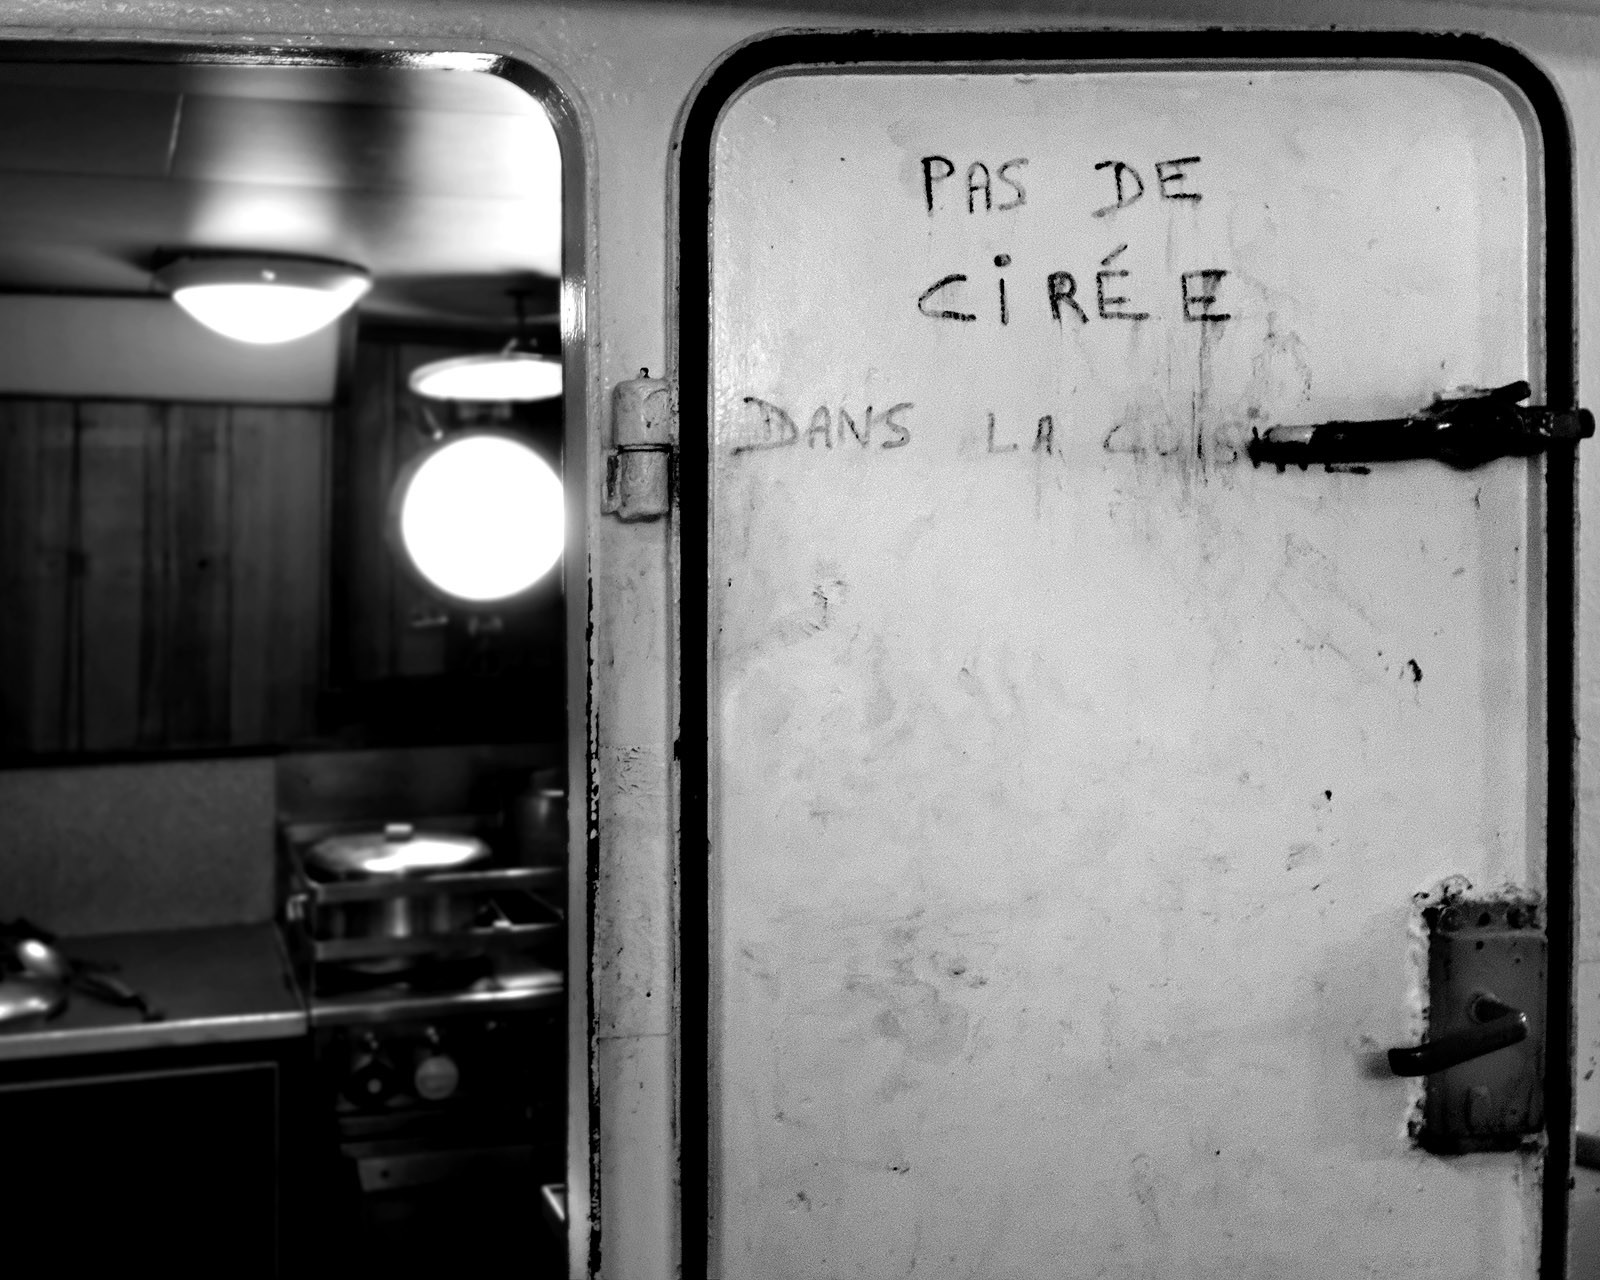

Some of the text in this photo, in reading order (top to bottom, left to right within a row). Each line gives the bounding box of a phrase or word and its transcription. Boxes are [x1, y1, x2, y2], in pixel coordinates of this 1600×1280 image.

[921, 155, 1202, 218] PAS DE
[731, 396, 914, 455] DANS
[987, 412, 1053, 455] LA
